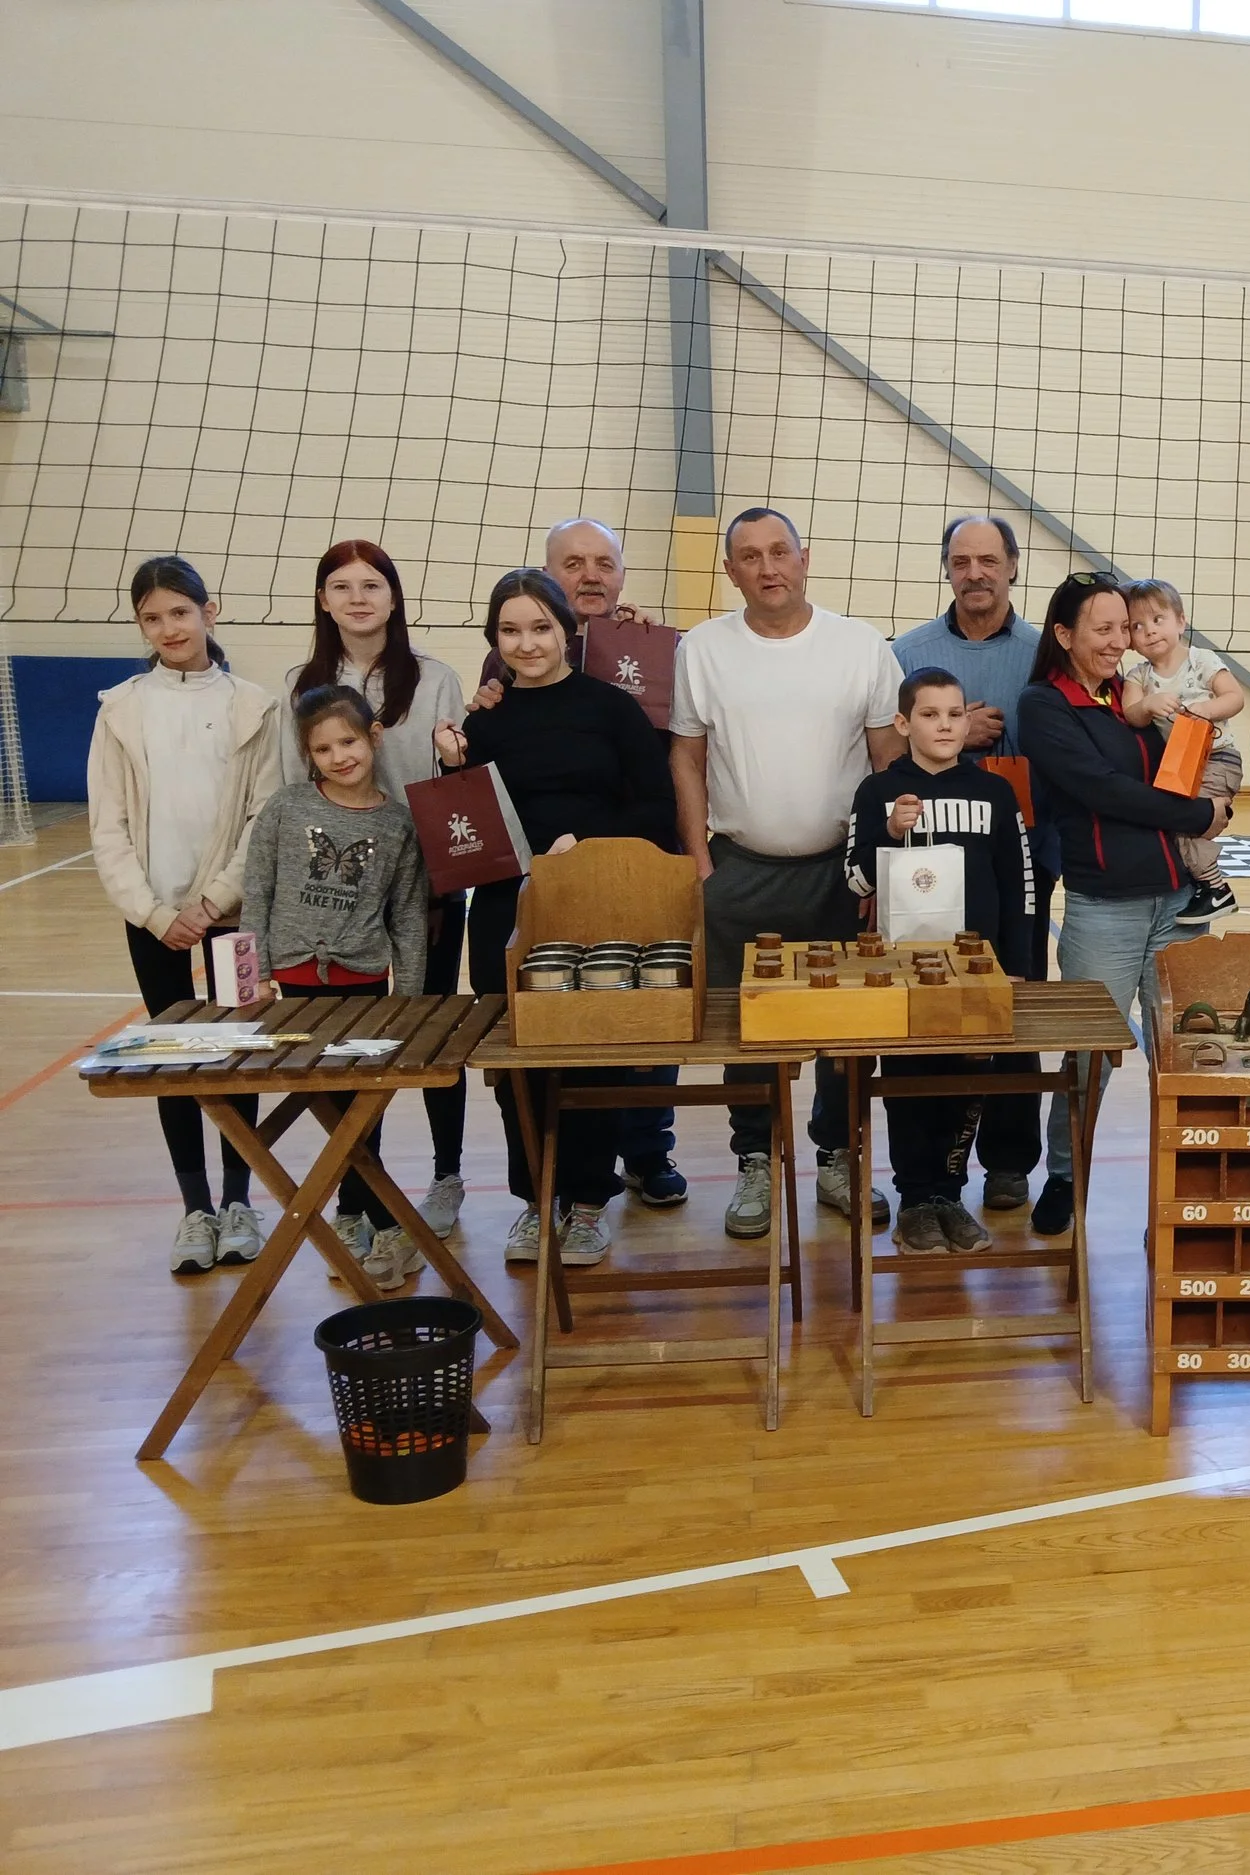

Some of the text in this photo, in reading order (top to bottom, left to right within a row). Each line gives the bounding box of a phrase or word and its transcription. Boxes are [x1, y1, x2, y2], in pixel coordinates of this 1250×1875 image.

[884, 798, 992, 835] UMA
[300, 891, 330, 908] TAKE
[1181, 1129, 1220, 1145] 200
[1182, 1205, 1207, 1221] 60
[1180, 1280, 1217, 1296] 500
[1177, 1353, 1202, 1369] 80
